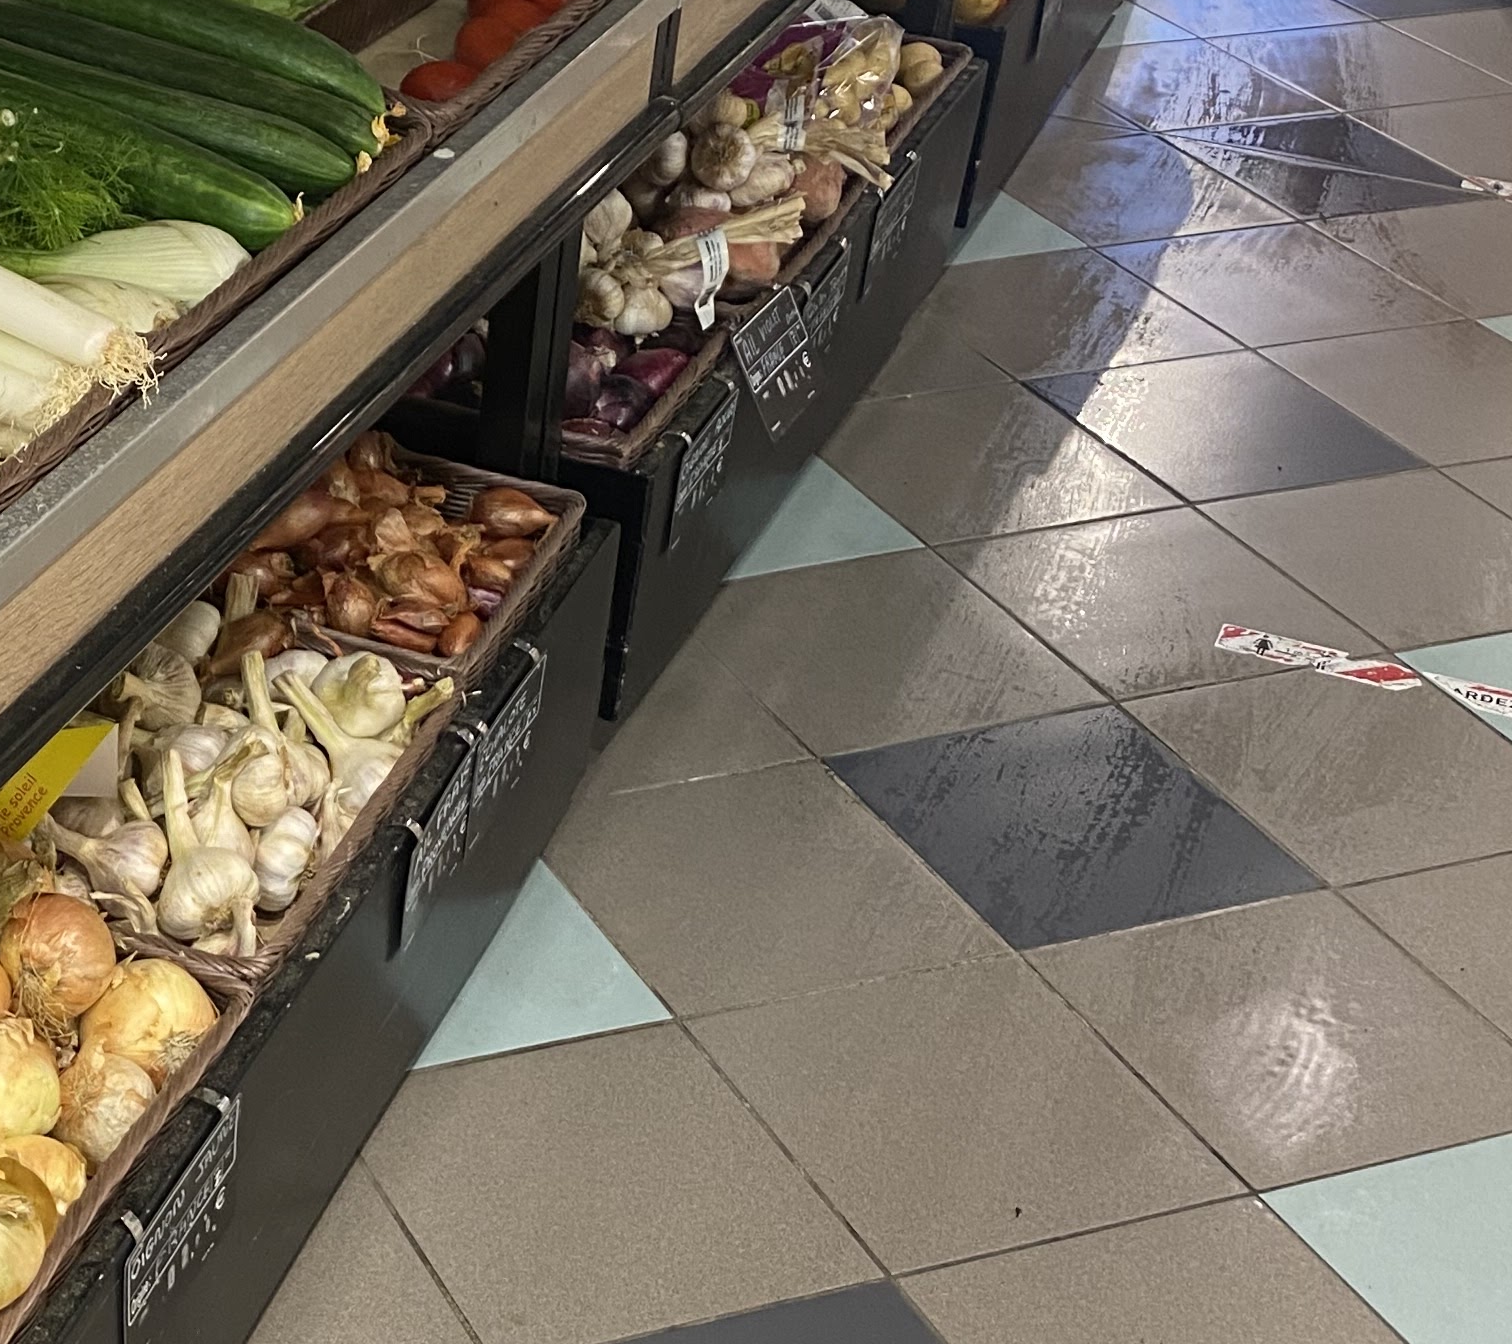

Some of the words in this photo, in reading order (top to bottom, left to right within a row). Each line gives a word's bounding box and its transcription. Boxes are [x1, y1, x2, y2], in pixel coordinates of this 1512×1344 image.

[758, 307, 781, 342] VIOLET
[0, 785, 49, 838] Provence
[9, 772, 38, 809] soleil
[130, 1189, 185, 1281] OIGNON
